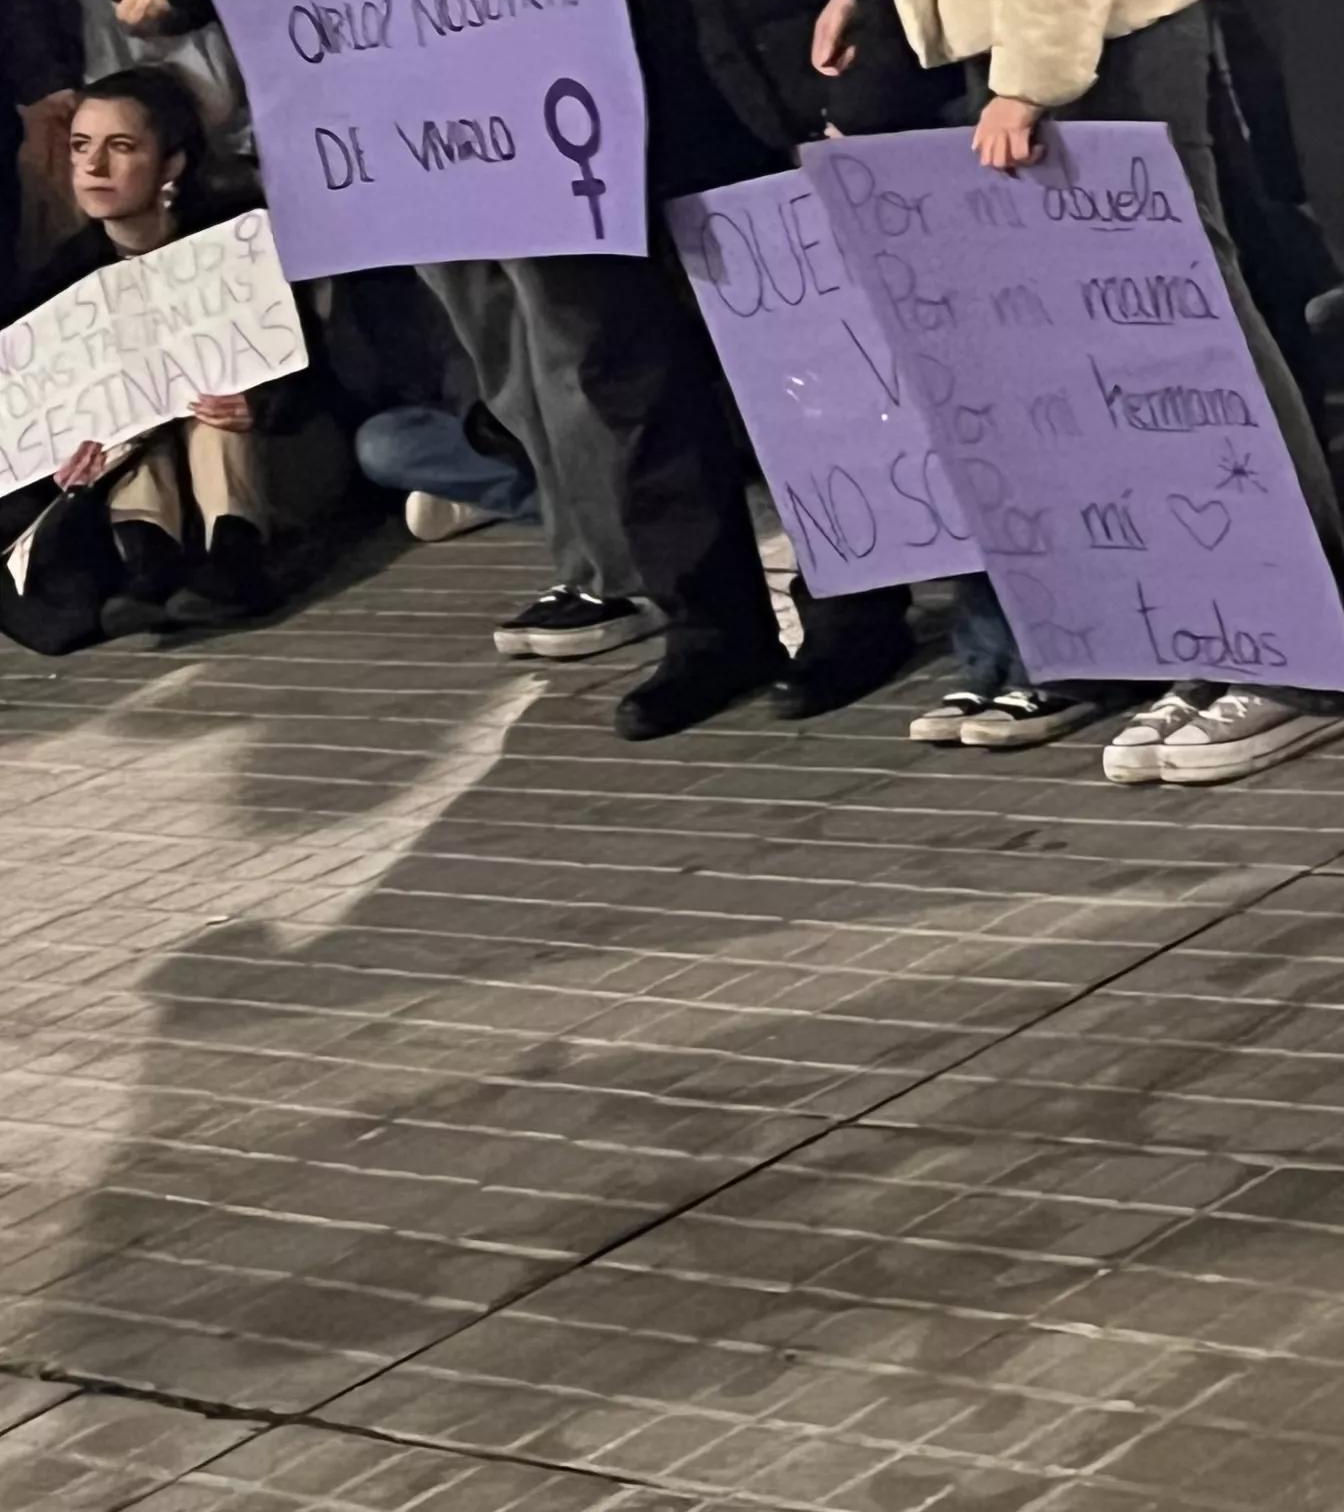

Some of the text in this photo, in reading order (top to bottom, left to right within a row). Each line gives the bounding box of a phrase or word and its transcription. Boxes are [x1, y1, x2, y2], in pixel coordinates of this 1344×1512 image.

[314, 126, 376, 191] DE
[830, 152, 933, 236] Por
[1043, 155, 1183, 224] abuela
[873, 249, 958, 332] Por
[1080, 260, 1220, 322] mamá
[914, 352, 996, 445] Por
[785, 465, 876, 571] NO
[953, 456, 1053, 553] Por
[1136, 579, 1288, 668] todas
